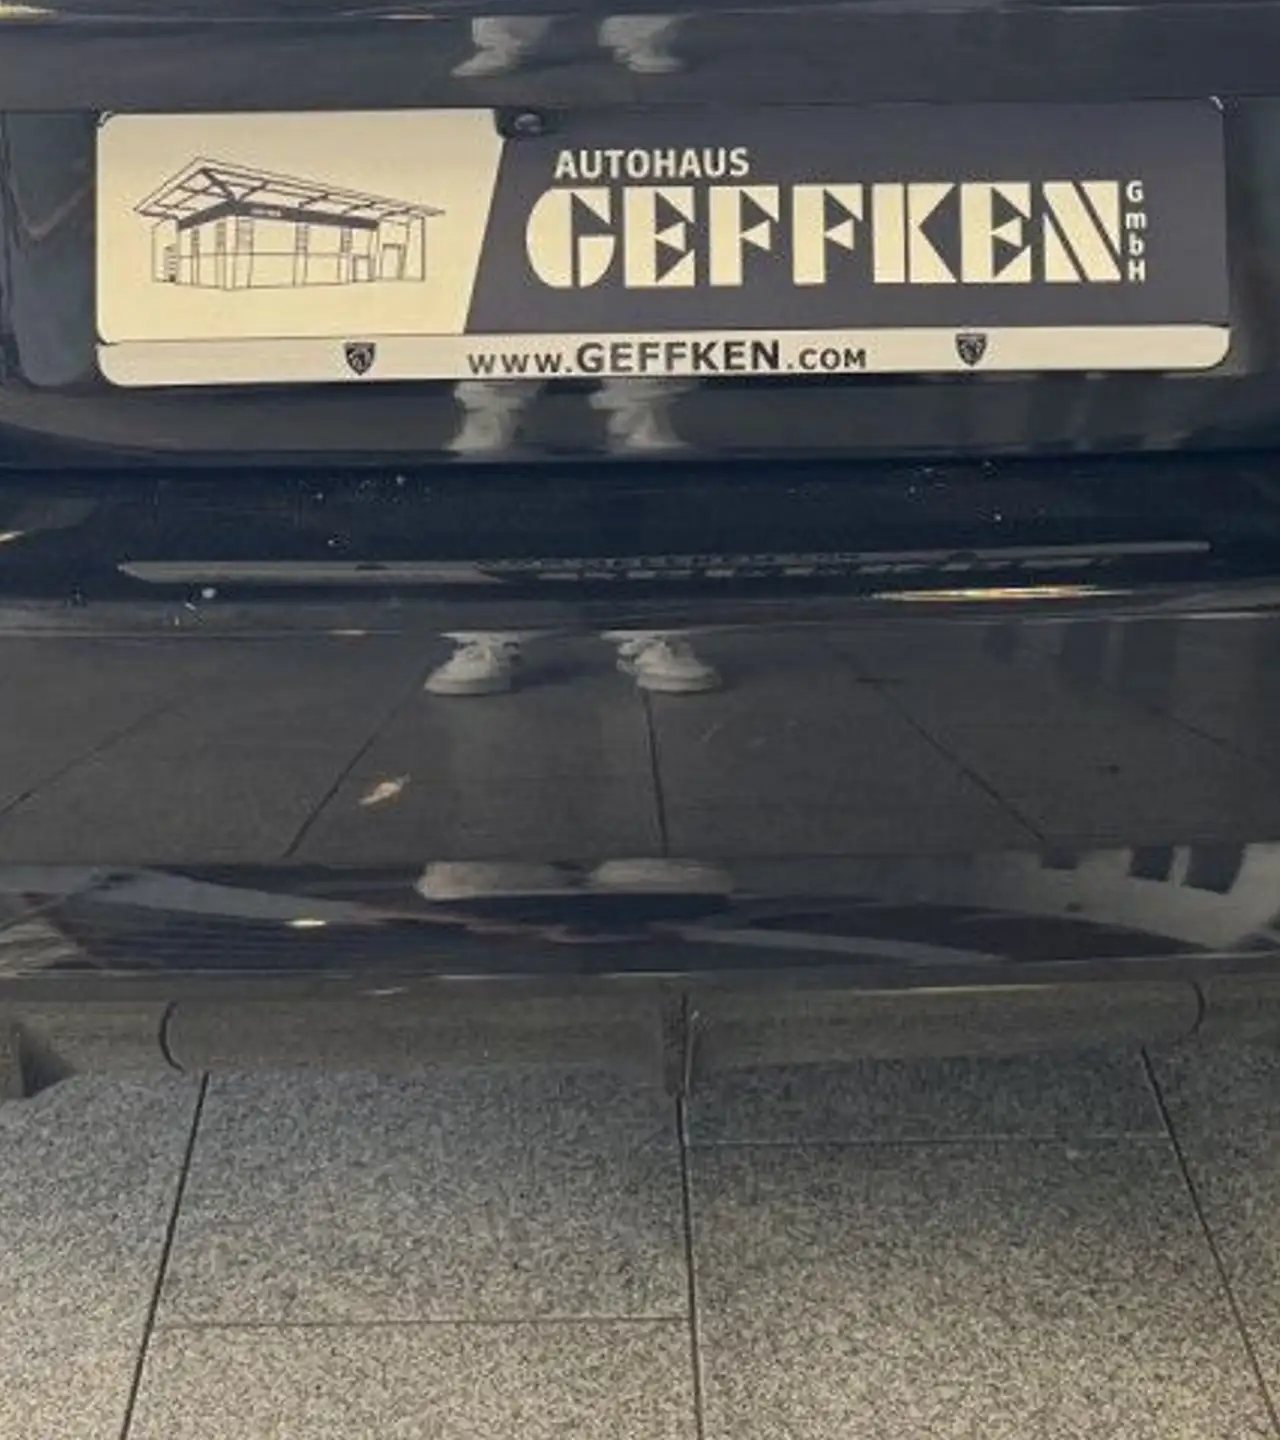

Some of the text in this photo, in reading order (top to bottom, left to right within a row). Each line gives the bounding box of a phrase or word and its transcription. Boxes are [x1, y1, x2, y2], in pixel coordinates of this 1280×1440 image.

[554, 147, 751, 179] AUTOHAUS
[525, 180, 1122, 289] GEFFKEN
[1125, 180, 1148, 283] GmbH
